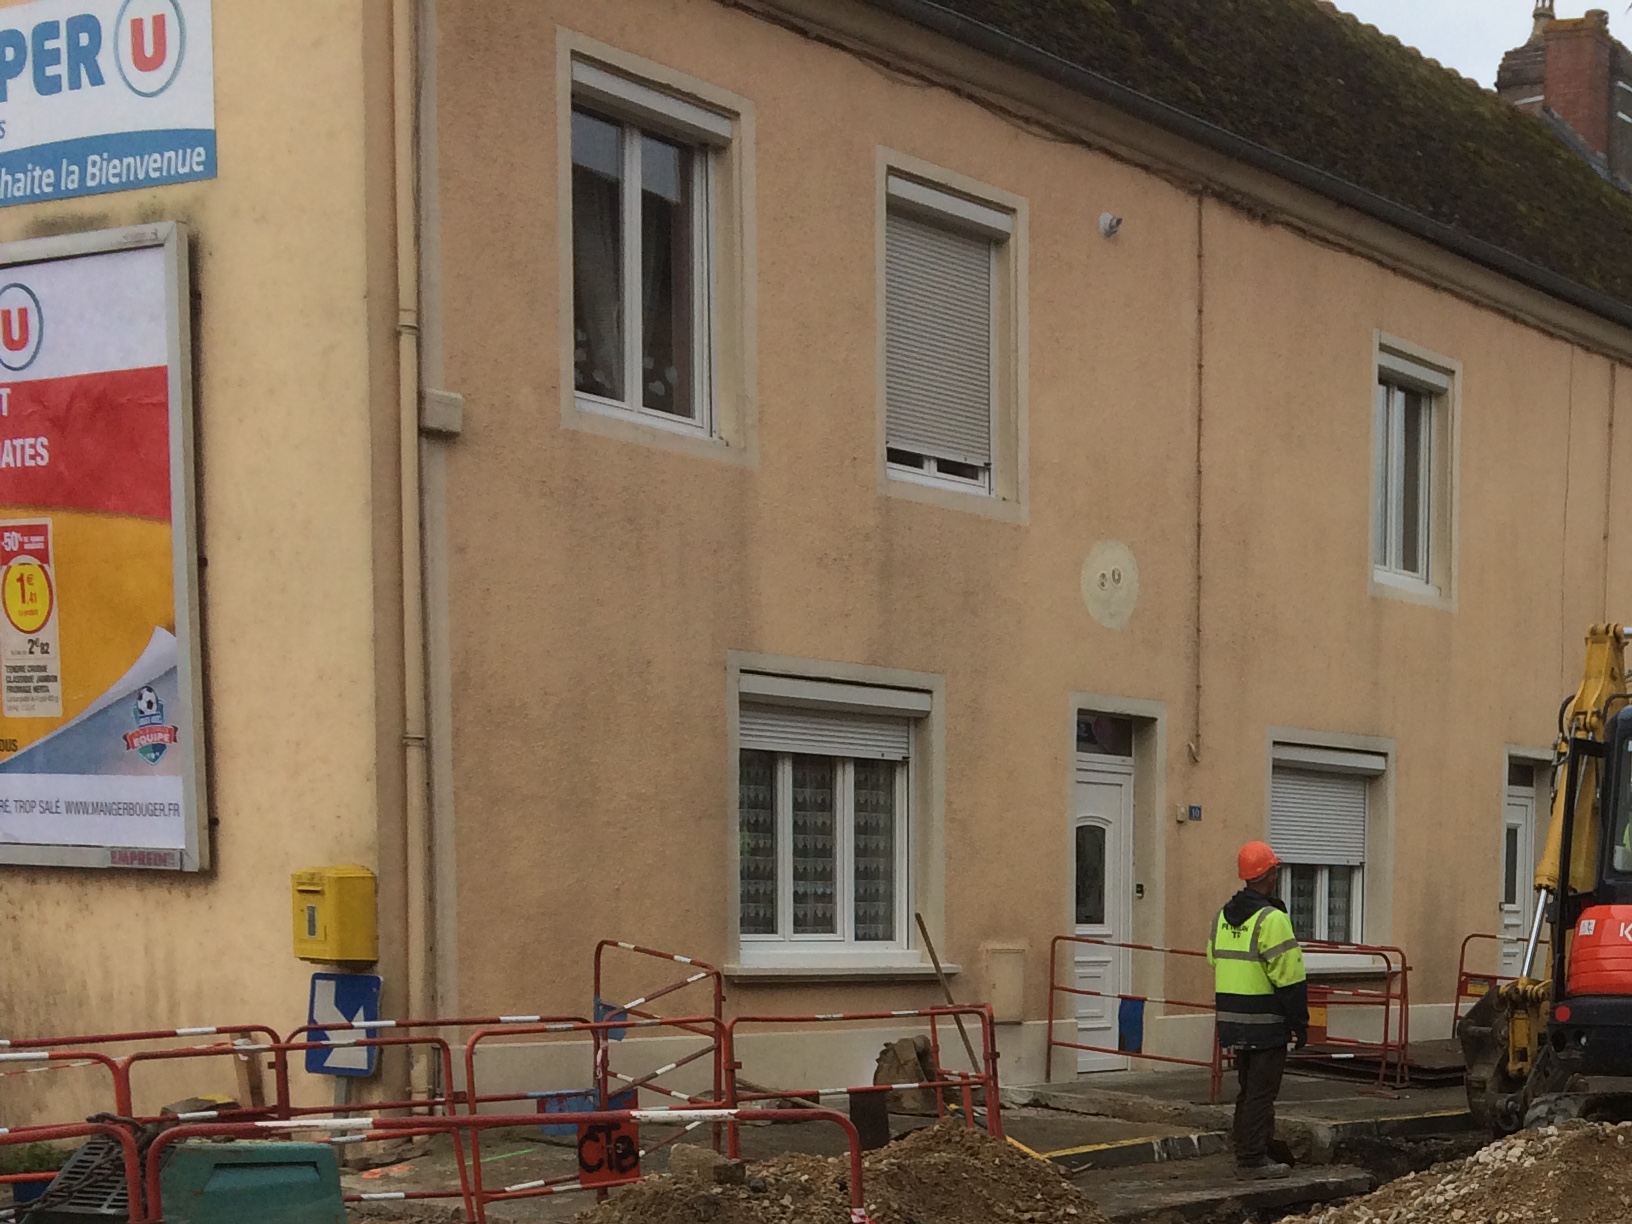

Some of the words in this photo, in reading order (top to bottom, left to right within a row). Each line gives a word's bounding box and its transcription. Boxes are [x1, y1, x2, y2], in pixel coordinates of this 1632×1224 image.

[130, 13, 167, 73] U
[60, 158, 80, 191] la
[85, 146, 206, 187] Bienvenue
[1, 306, 29, 352] U
[13, 799, 36, 814] TROP
[64, 800, 180, 818] WWW.MANGERBOUGER.FR
